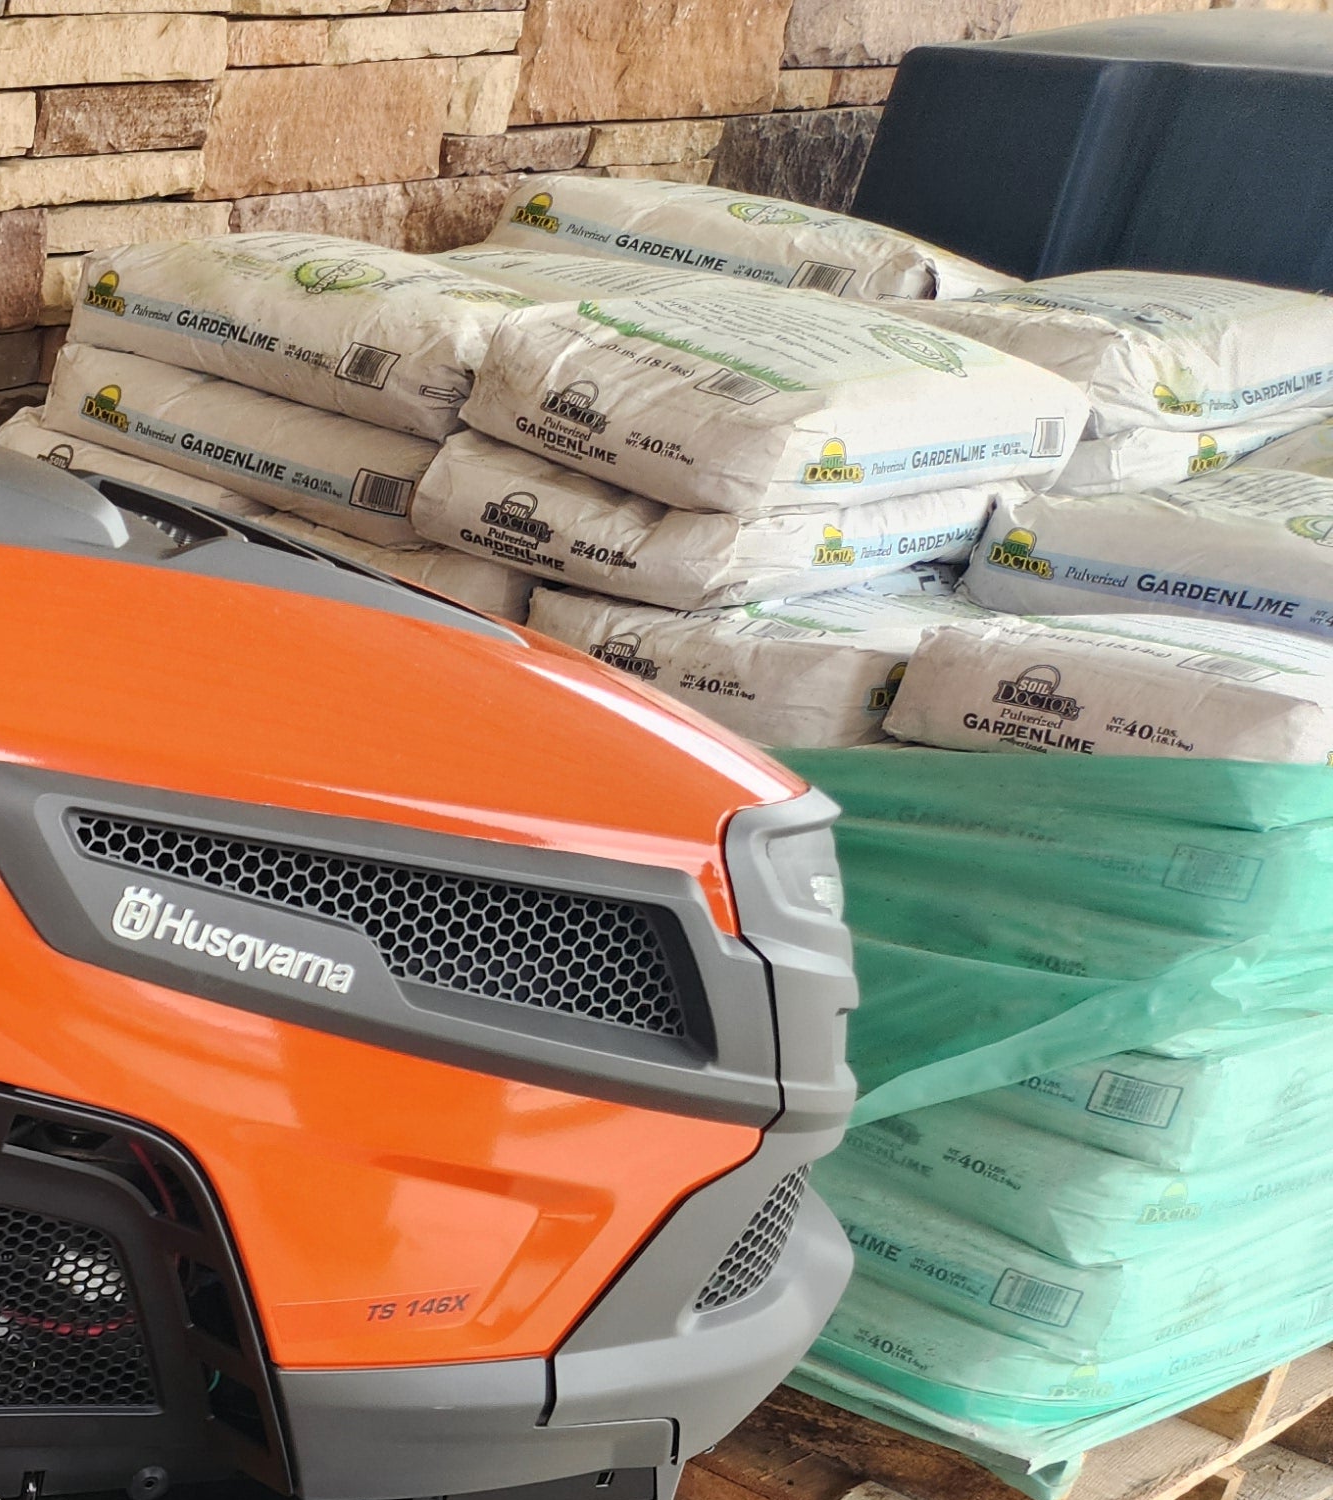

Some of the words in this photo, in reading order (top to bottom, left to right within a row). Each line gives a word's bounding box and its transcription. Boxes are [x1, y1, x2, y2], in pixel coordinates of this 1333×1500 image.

[565, 223, 612, 245] Pulverized
[742, 266, 762, 280] 40
[132, 303, 173, 322] Pulverized
[293, 348, 311, 363] 40
[135, 421, 177, 445] Pulverized
[543, 416, 593, 442] Pulverized
[639, 435, 664, 455] 40
[302, 475, 320, 491] 40
[501, 502, 531, 519] SOIL
[487, 526, 539, 551] Pulverized
[584, 544, 609, 563] 40
[1065, 565, 1129, 589] Pulverized
[606, 642, 633, 657] SOIL
[695, 675, 720, 695] 40
[1018, 679, 1050, 695] SOIL
[1000, 708, 1064, 730] Pulverized
[1111, 716, 1126, 726] NT.
[962, 713, 1096, 756] GARDENLIME
[1105, 724, 1122, 735] WT.
[1123, 720, 1153, 741] 40
[153, 902, 355, 995] Husqvarna
[958, 1154, 985, 1174] 40
[921, 1264, 947, 1281] 40
[366, 1302, 398, 1322] TS
[406, 1293, 471, 1318] 146X
[867, 1335, 893, 1354] 40
